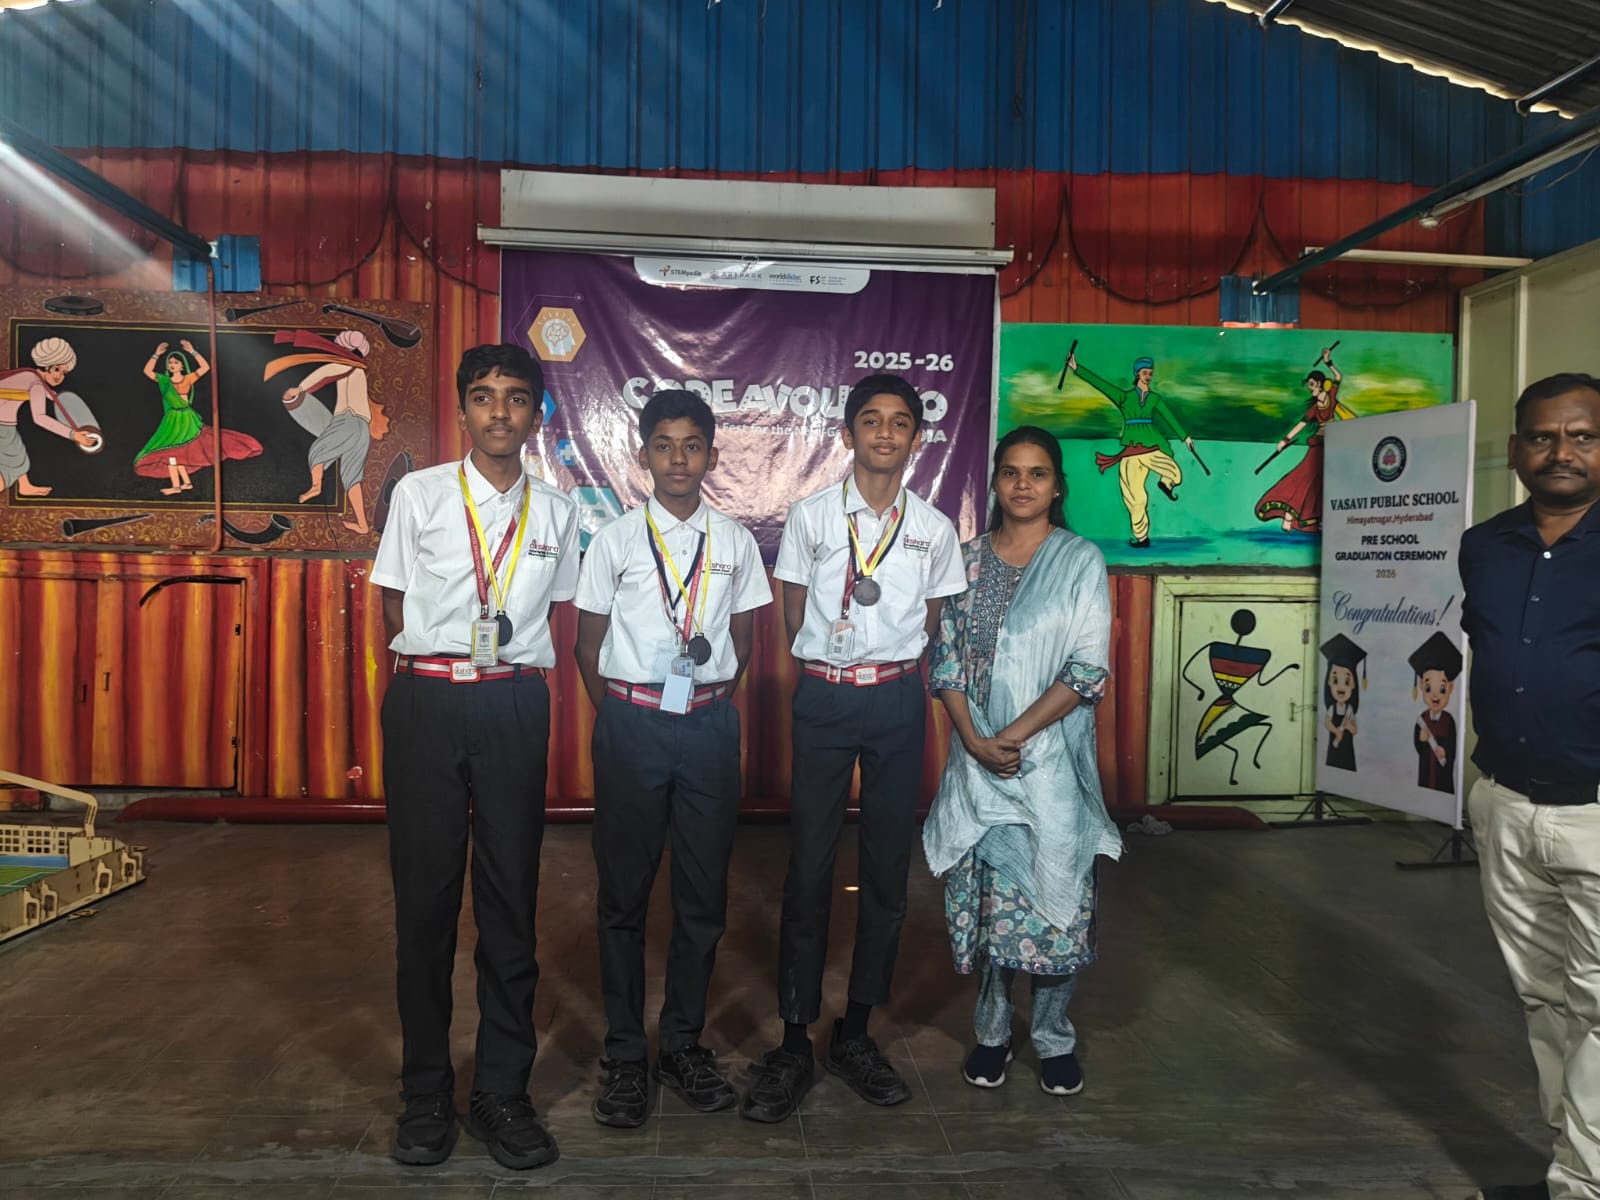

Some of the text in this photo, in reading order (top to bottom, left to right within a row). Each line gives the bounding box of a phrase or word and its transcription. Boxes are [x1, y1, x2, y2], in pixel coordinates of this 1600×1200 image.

[670, 268, 702, 277] STEMpedia
[854, 350, 954, 372] 2025-26
[622, 376, 855, 419] CDEAVOU
[722, 422, 747, 433] Fest
[751, 423, 768, 434] for
[772, 424, 792, 436] the
[1330, 491, 1459, 511] VASAVI PUBLIC SCHOOL
[1361, 534, 1420, 545] PRE SCHOOL
[1335, 550, 1447, 561] GRADUATION CEREMONY
[1376, 569, 1396, 579] 2026
[1332, 590, 1455, 635] Congratulations!
